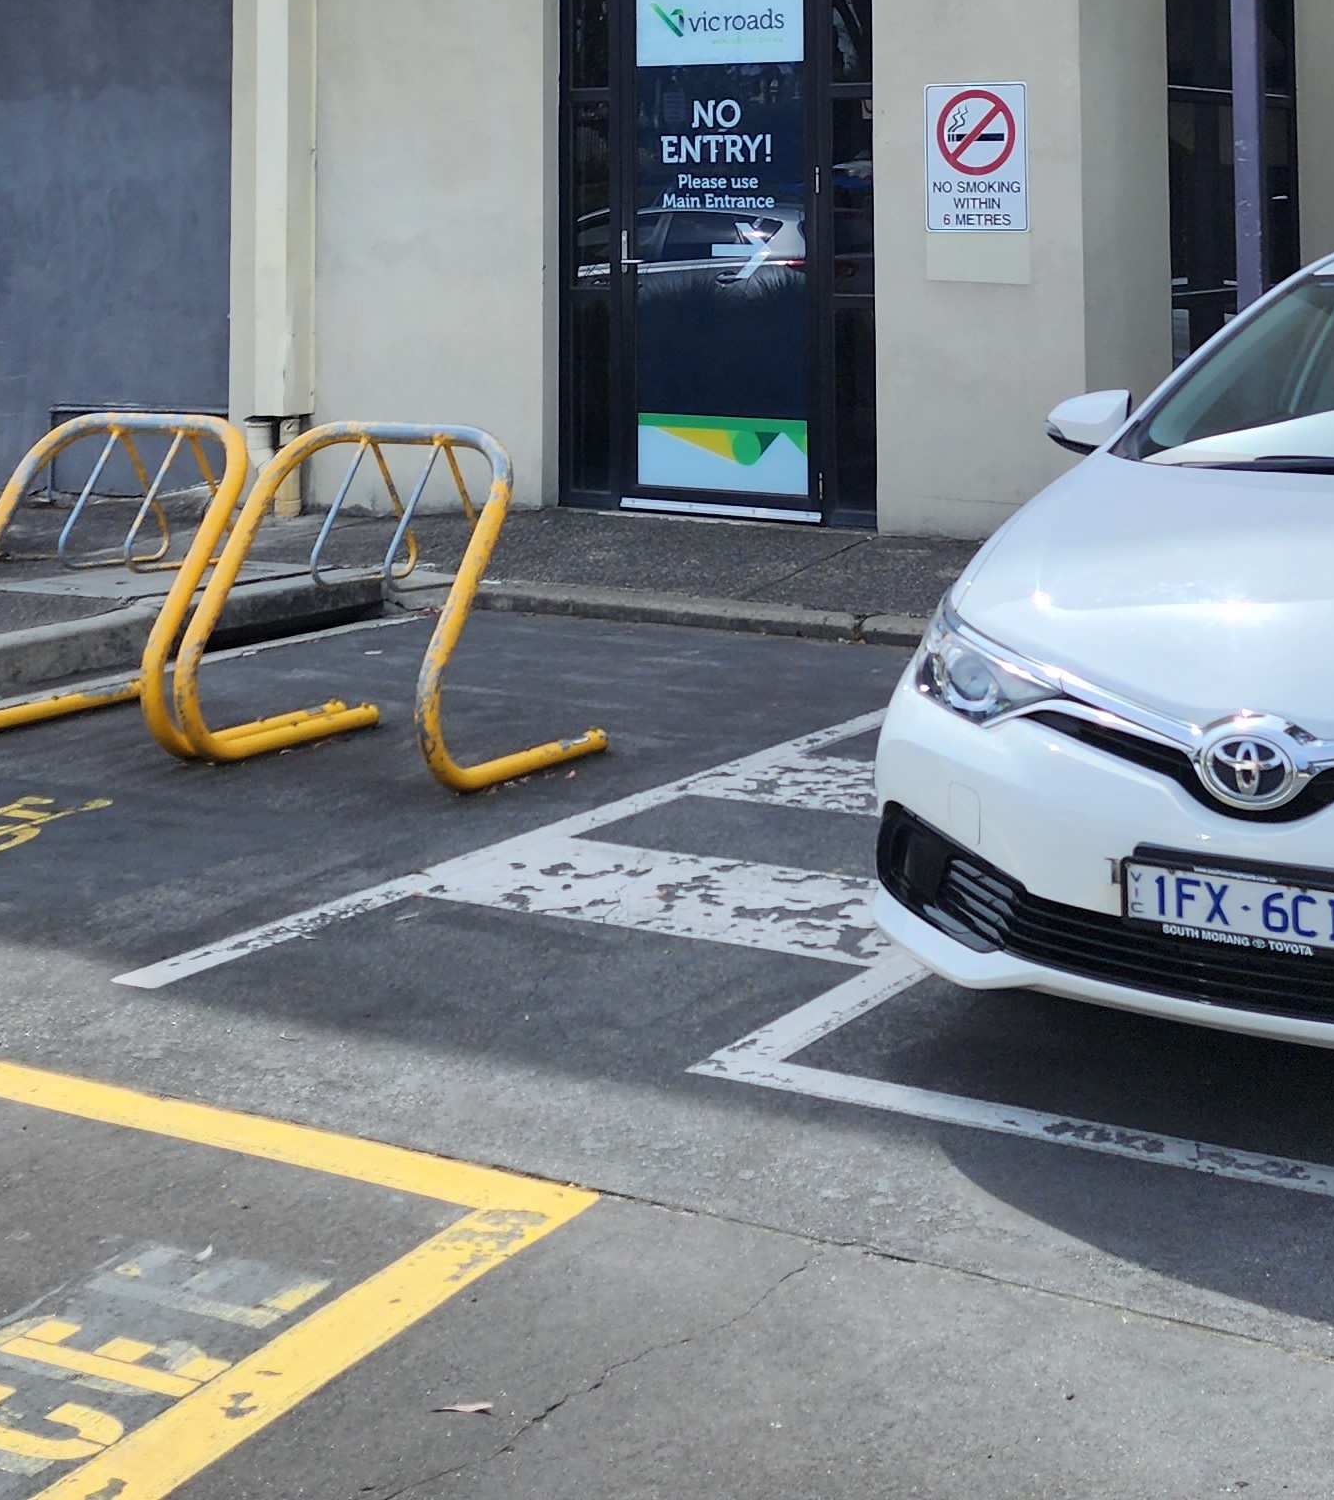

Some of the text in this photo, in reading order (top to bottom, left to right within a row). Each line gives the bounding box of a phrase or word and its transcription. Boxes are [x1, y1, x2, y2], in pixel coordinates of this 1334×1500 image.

[691, 99, 742, 129] NO
[660, 133, 772, 164] ENTRY!
[677, 174, 759, 189] Please use
[932, 181, 1021, 194] NO SMOKING
[662, 193, 775, 209] Main Entrance
[953, 197, 1001, 209] WITHIN
[943, 213, 1012, 226] 6 METRES
[1162, 923, 1315, 958] SOUTH MORANG TOYOTA
